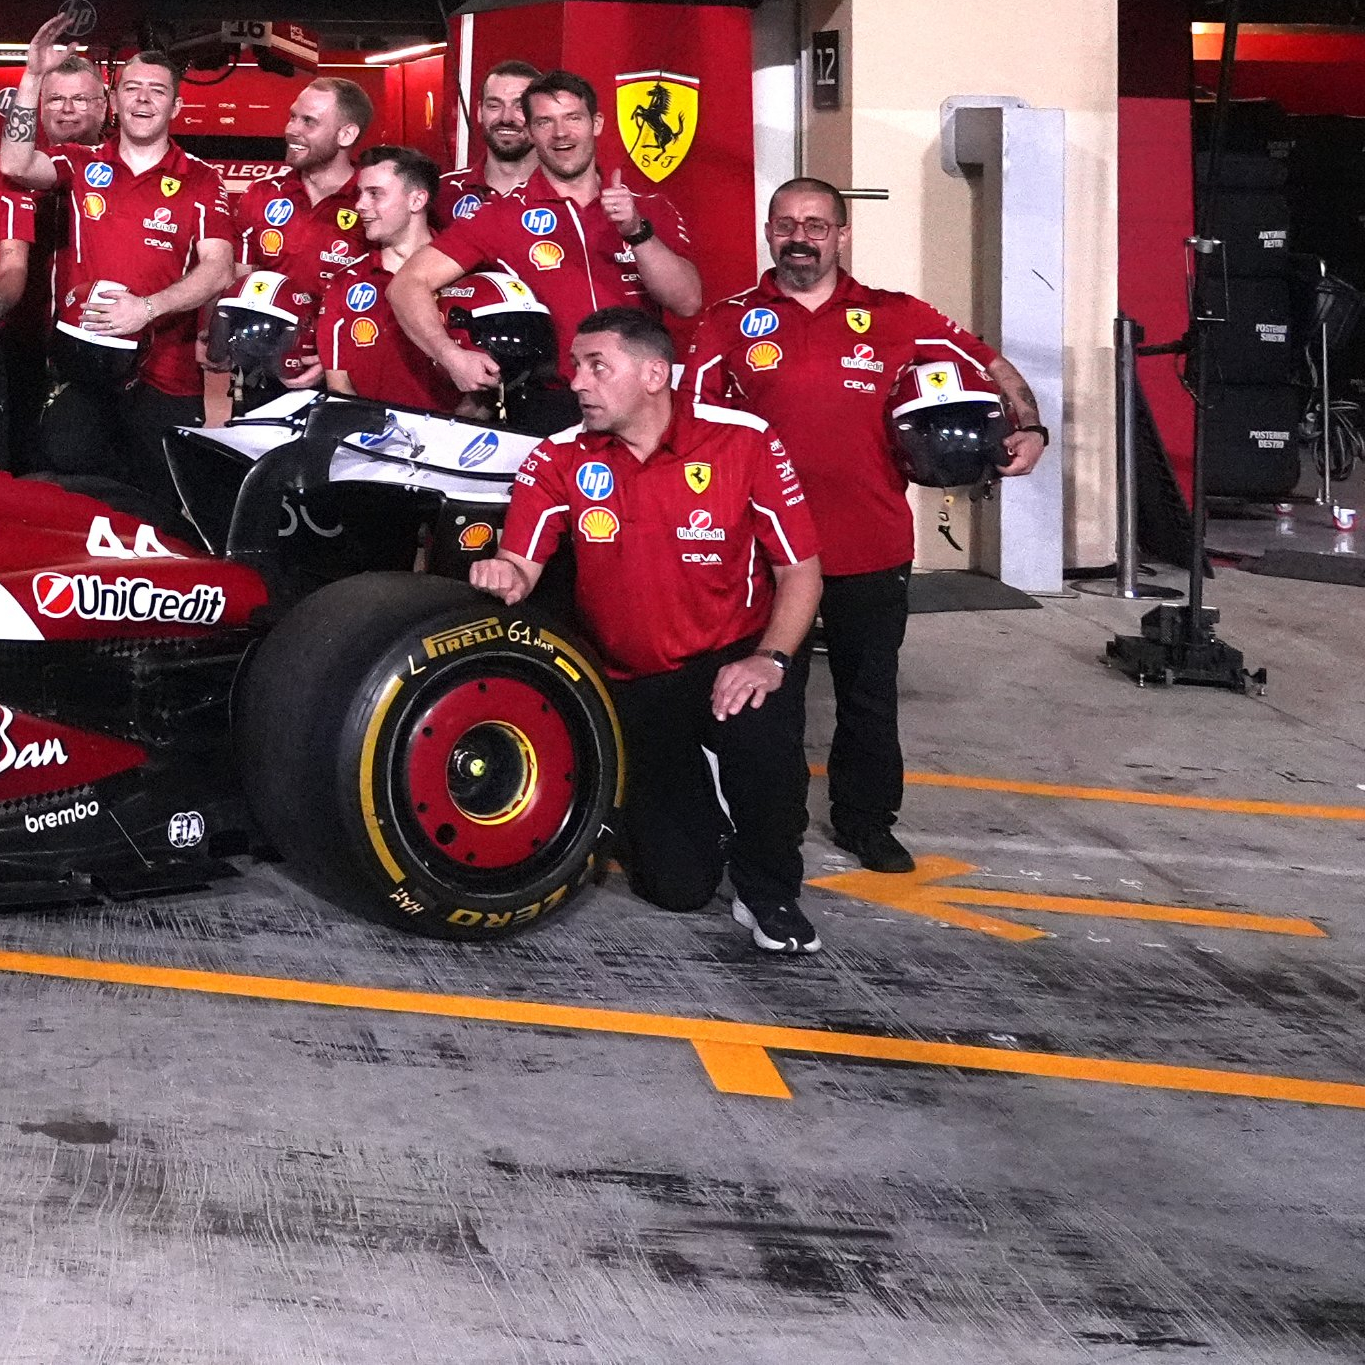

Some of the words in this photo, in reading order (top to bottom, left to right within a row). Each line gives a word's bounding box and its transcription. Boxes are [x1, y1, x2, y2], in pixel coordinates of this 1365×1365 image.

[816, 47, 836, 85] 12
[86, 163, 112, 187] hp
[226, 164, 273, 178] LECL
[266, 198, 291, 225] hp
[524, 209, 554, 234] hp
[142, 218, 178, 234] UniCredit
[621, 273, 643, 282] CEV
[348, 283, 375, 311] hp
[743, 309, 776, 336] hp
[841, 356, 884, 373] UniCredit
[461, 432, 496, 467] hp
[579, 462, 611, 500] hp
[85, 516, 185, 560] 44
[676, 526, 726, 541] UniCredit
[75, 577, 225, 624] UniCredit
[422, 616, 504, 660] PIRELLI
[507, 620, 532, 645] 61
[24, 799, 100, 833] brembo
[446, 884, 568, 929] ZERO
